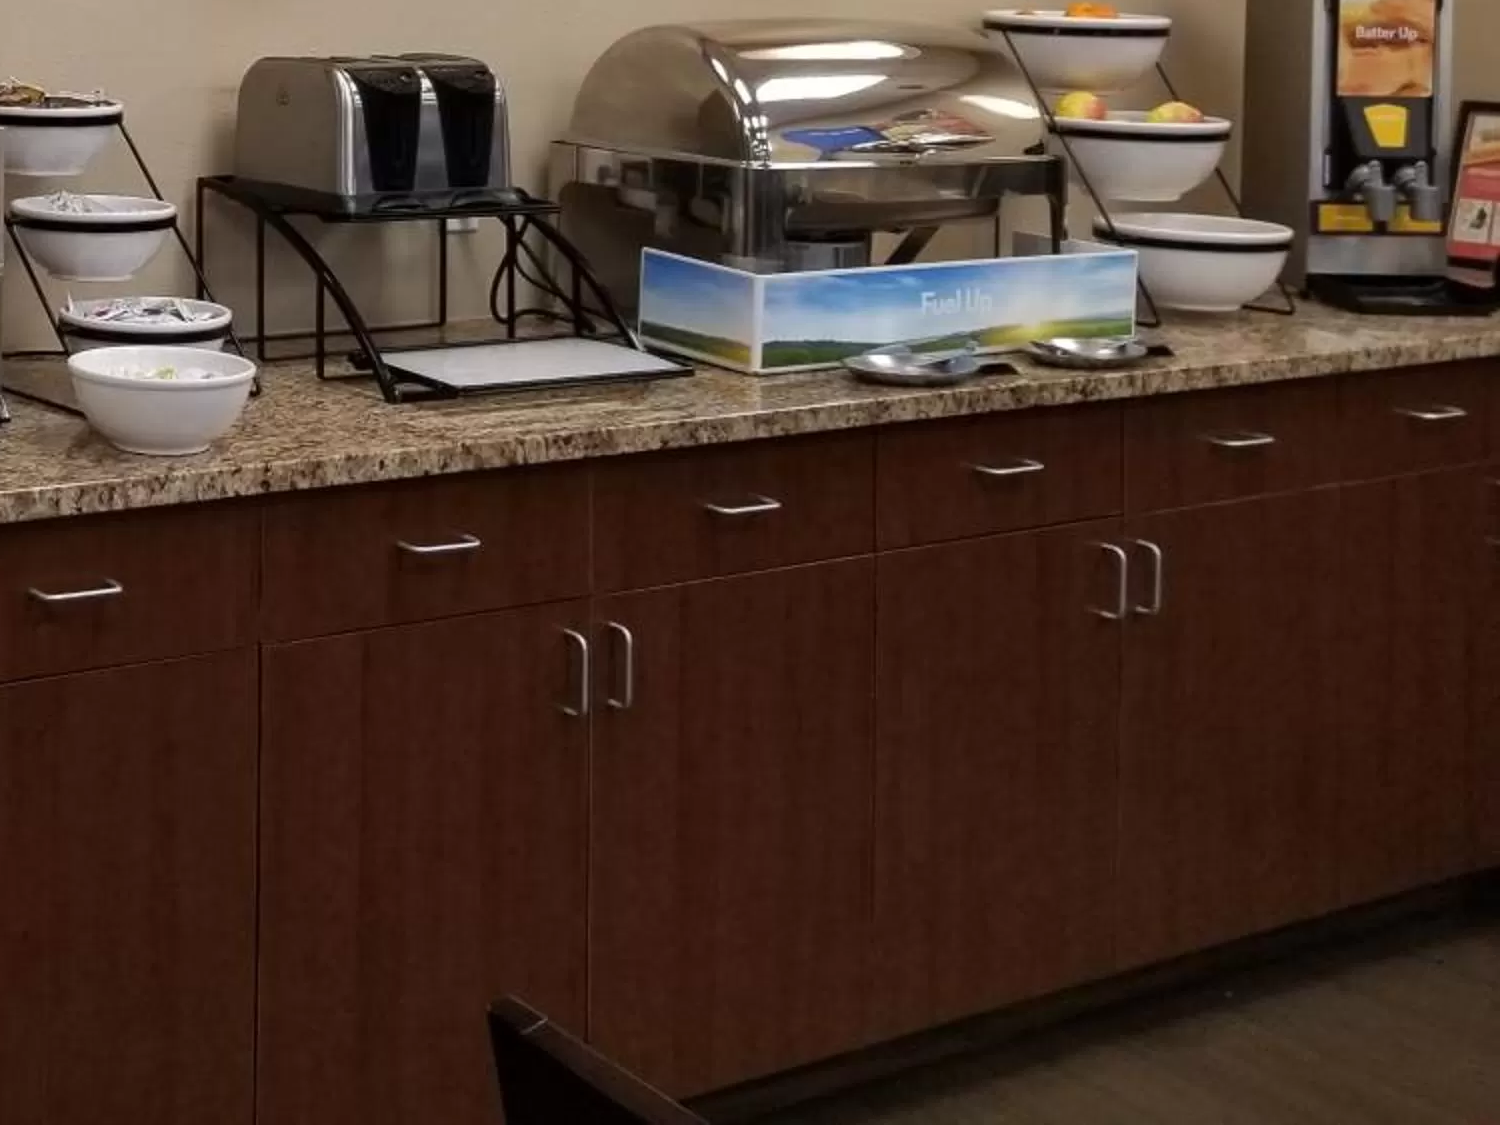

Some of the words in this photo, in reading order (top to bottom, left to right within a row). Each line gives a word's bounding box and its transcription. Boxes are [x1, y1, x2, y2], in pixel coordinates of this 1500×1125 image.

[1355, 26, 1396, 39] Batter
[1398, 26, 1418, 43] Up
[921, 288, 961, 315] Fuel
[965, 286, 993, 313] Up
